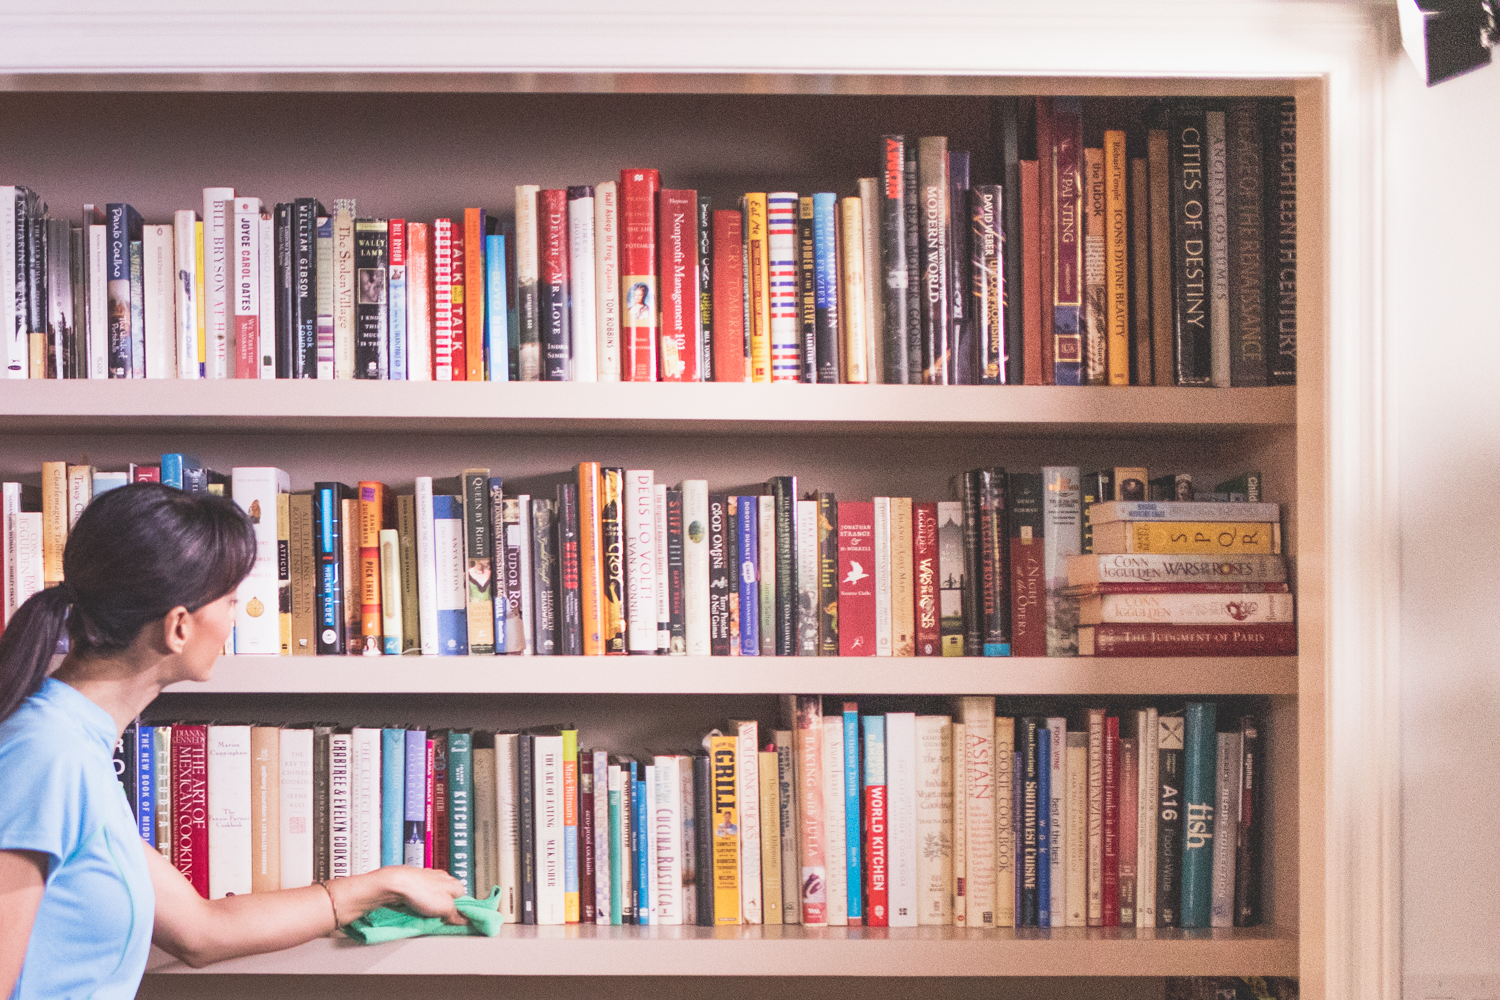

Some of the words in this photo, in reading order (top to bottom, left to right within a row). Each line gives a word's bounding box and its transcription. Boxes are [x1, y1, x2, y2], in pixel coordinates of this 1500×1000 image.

[1184, 127, 1201, 191] CITIES
[605, 192, 614, 206] Half
[1184, 200, 1202, 227] OF
[241, 218, 251, 247] JOYCE
[605, 209, 614, 232] Asleep
[241, 250, 251, 279] CAROL
[453, 238, 463, 282] TALK
[604, 245, 614, 261] Frog
[606, 263, 614, 293] Pajamas
[1184, 236, 1205, 329] DESTINY
[242, 283, 251, 311] OATES
[606, 298, 615, 314] TOM
[453, 307, 463, 350] TALK
[607, 317, 615, 348] ROBBINS
[474, 477, 484, 508] QUEEN
[637, 476, 652, 516] DEUS
[475, 511, 484, 523] BY
[476, 526, 485, 556] RIGHT
[639, 523, 652, 544] LO
[640, 551, 653, 599] VOLT!
[192, 747, 205, 775] THE
[192, 780, 205, 805] ART
[716, 750, 735, 813] GRILL
[193, 808, 205, 828] OF
[872, 787, 883, 834] WORLD
[873, 837, 884, 891] KITCHEN
